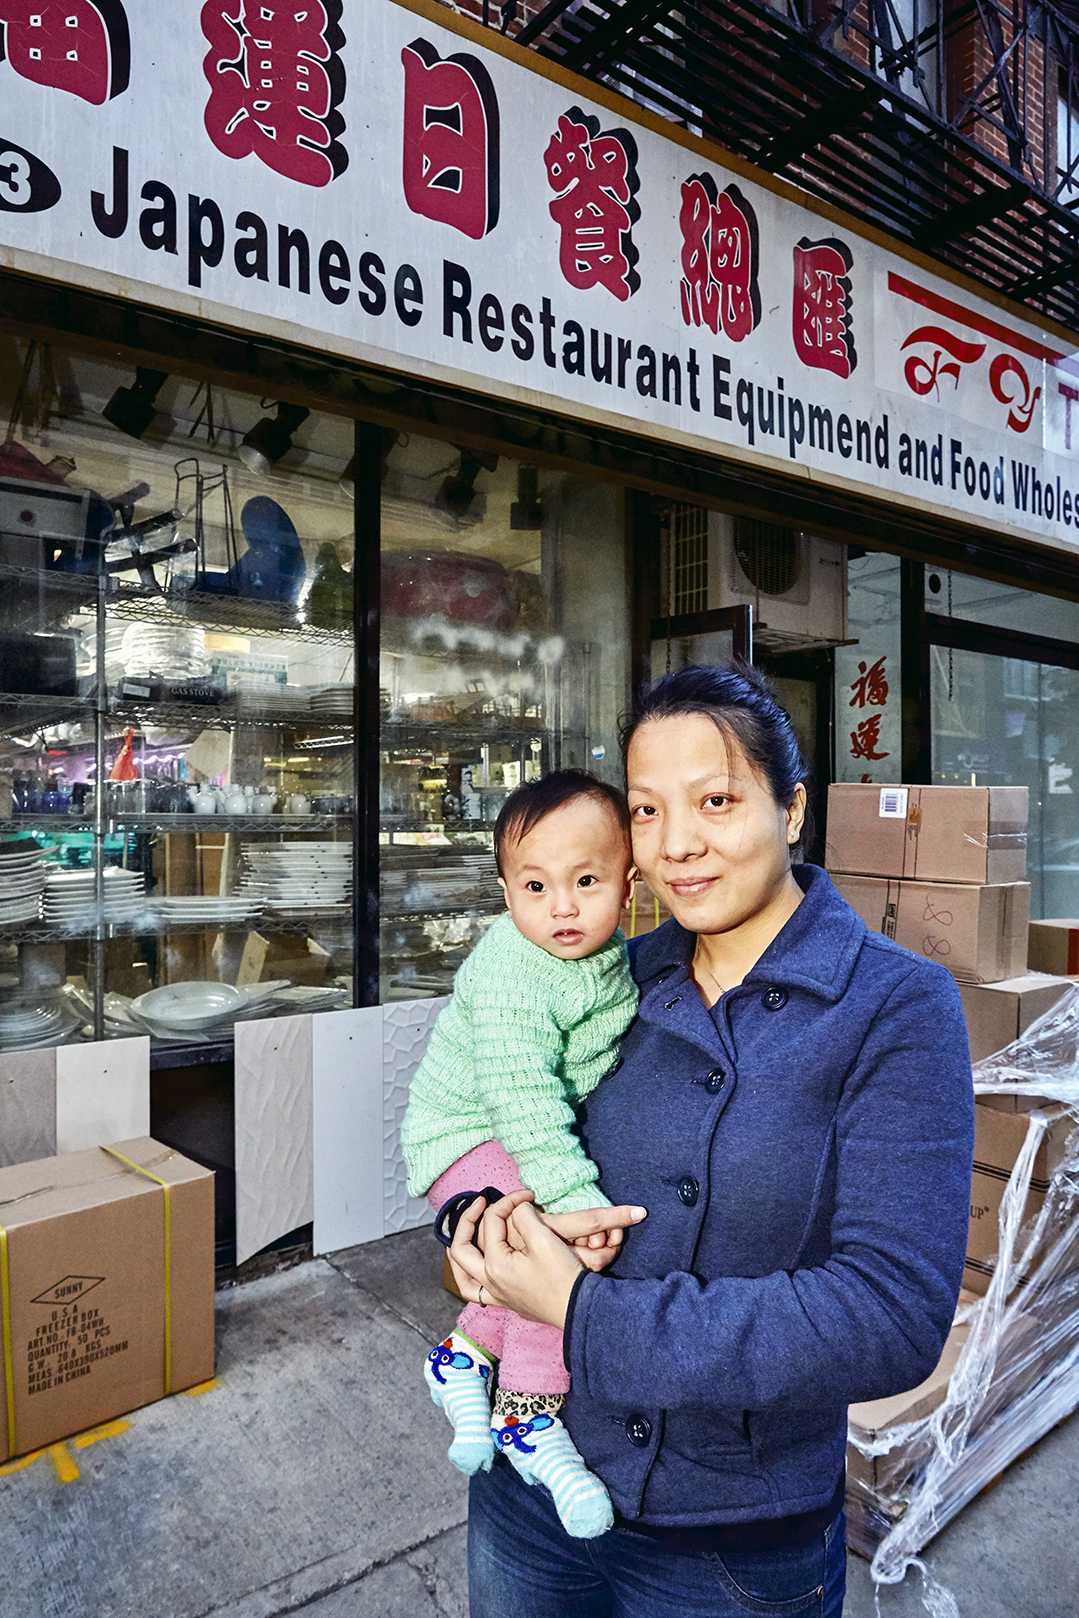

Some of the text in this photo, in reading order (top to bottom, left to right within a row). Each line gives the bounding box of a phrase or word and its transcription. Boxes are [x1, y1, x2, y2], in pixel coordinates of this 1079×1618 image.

[91, 146, 423, 327] Japanese
[432, 259, 701, 413] Restaurant
[713, 354, 889, 470] Equipmend
[899, 433, 943, 486] and
[951, 439, 1005, 505] Food
[171, 686, 215, 698] GAS STOVE
[849, 656, 890, 784] 福運
[54, 1281, 84, 1300] SUNNY
[36, 1308, 99, 1338] FREEZER BOX
[77, 1333, 88, 1346] 50
[94, 1324, 111, 1340] PCS
[85, 1339, 101, 1354] KGS
[28, 1364, 91, 1396] MADE IN CHINA
